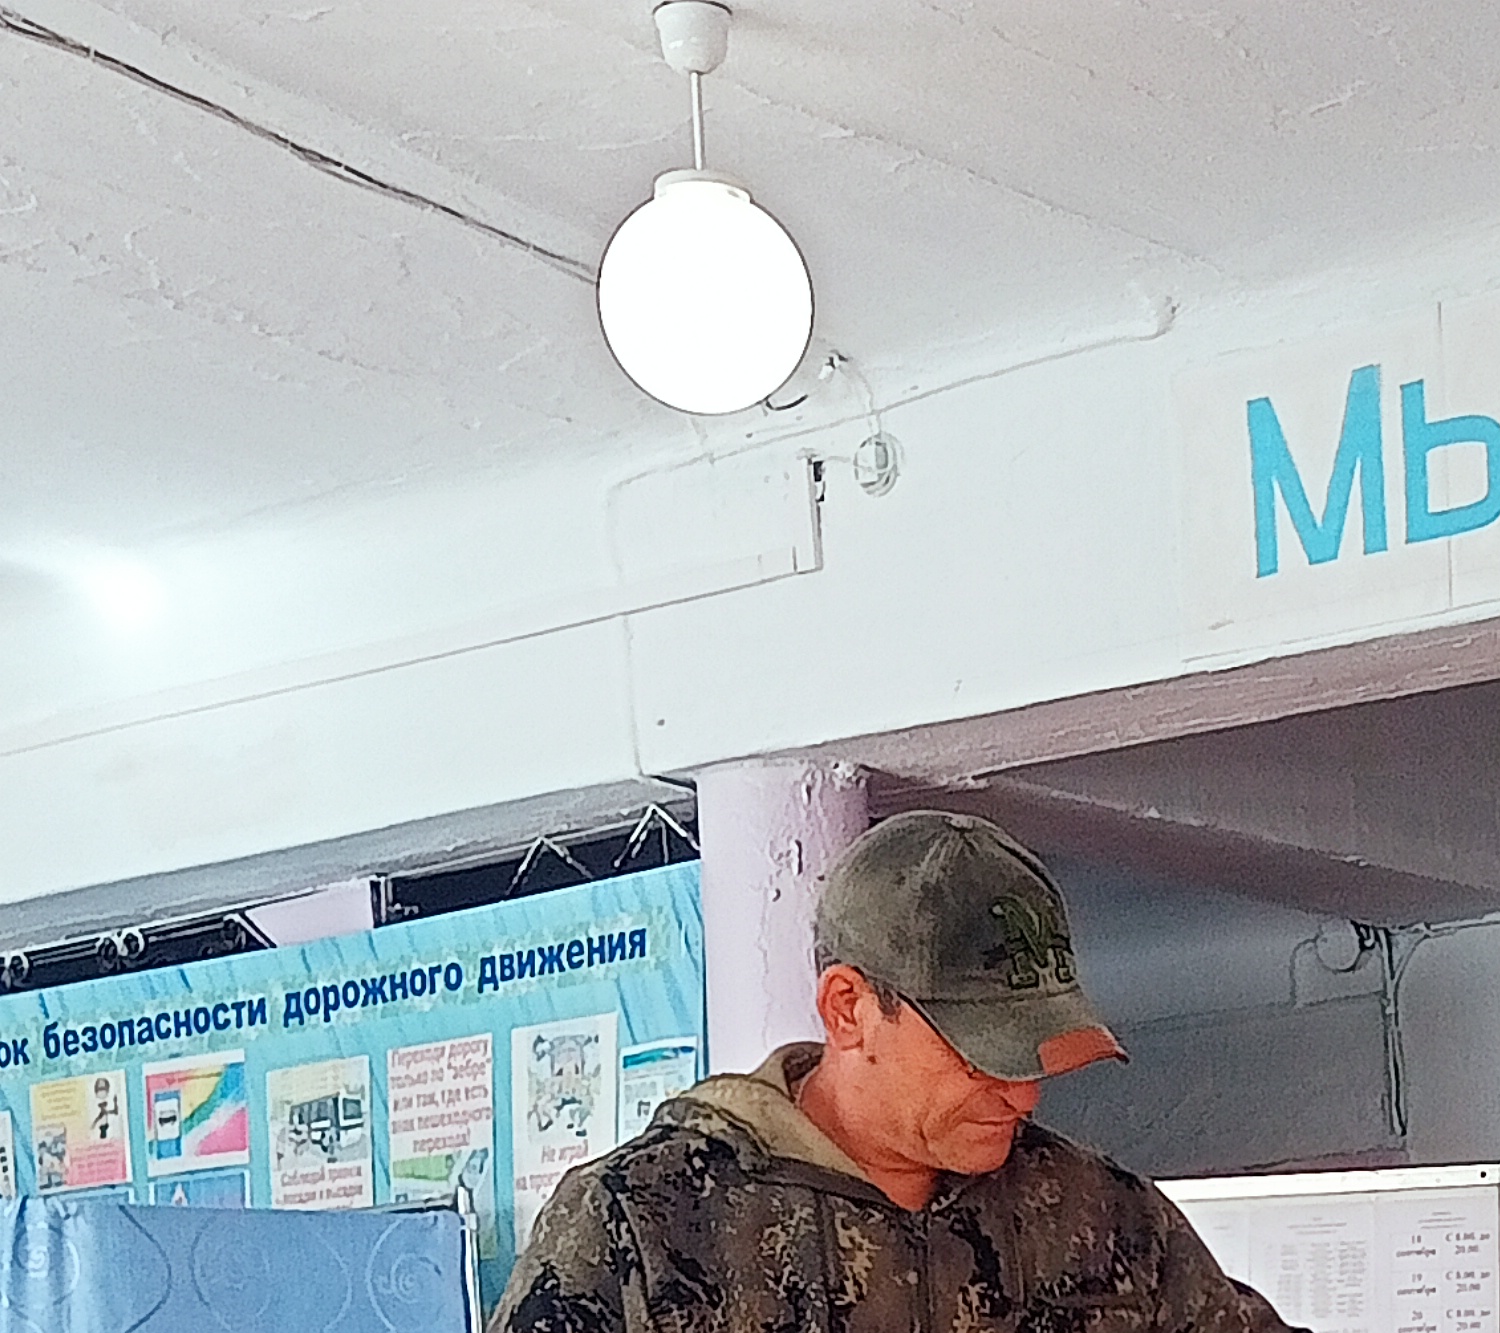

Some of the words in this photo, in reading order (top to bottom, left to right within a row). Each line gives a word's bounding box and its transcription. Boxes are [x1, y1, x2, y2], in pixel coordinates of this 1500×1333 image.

[43, 998, 267, 1060] безопасности
[283, 962, 463, 1027] дорожного
[479, 928, 647, 993] движения
